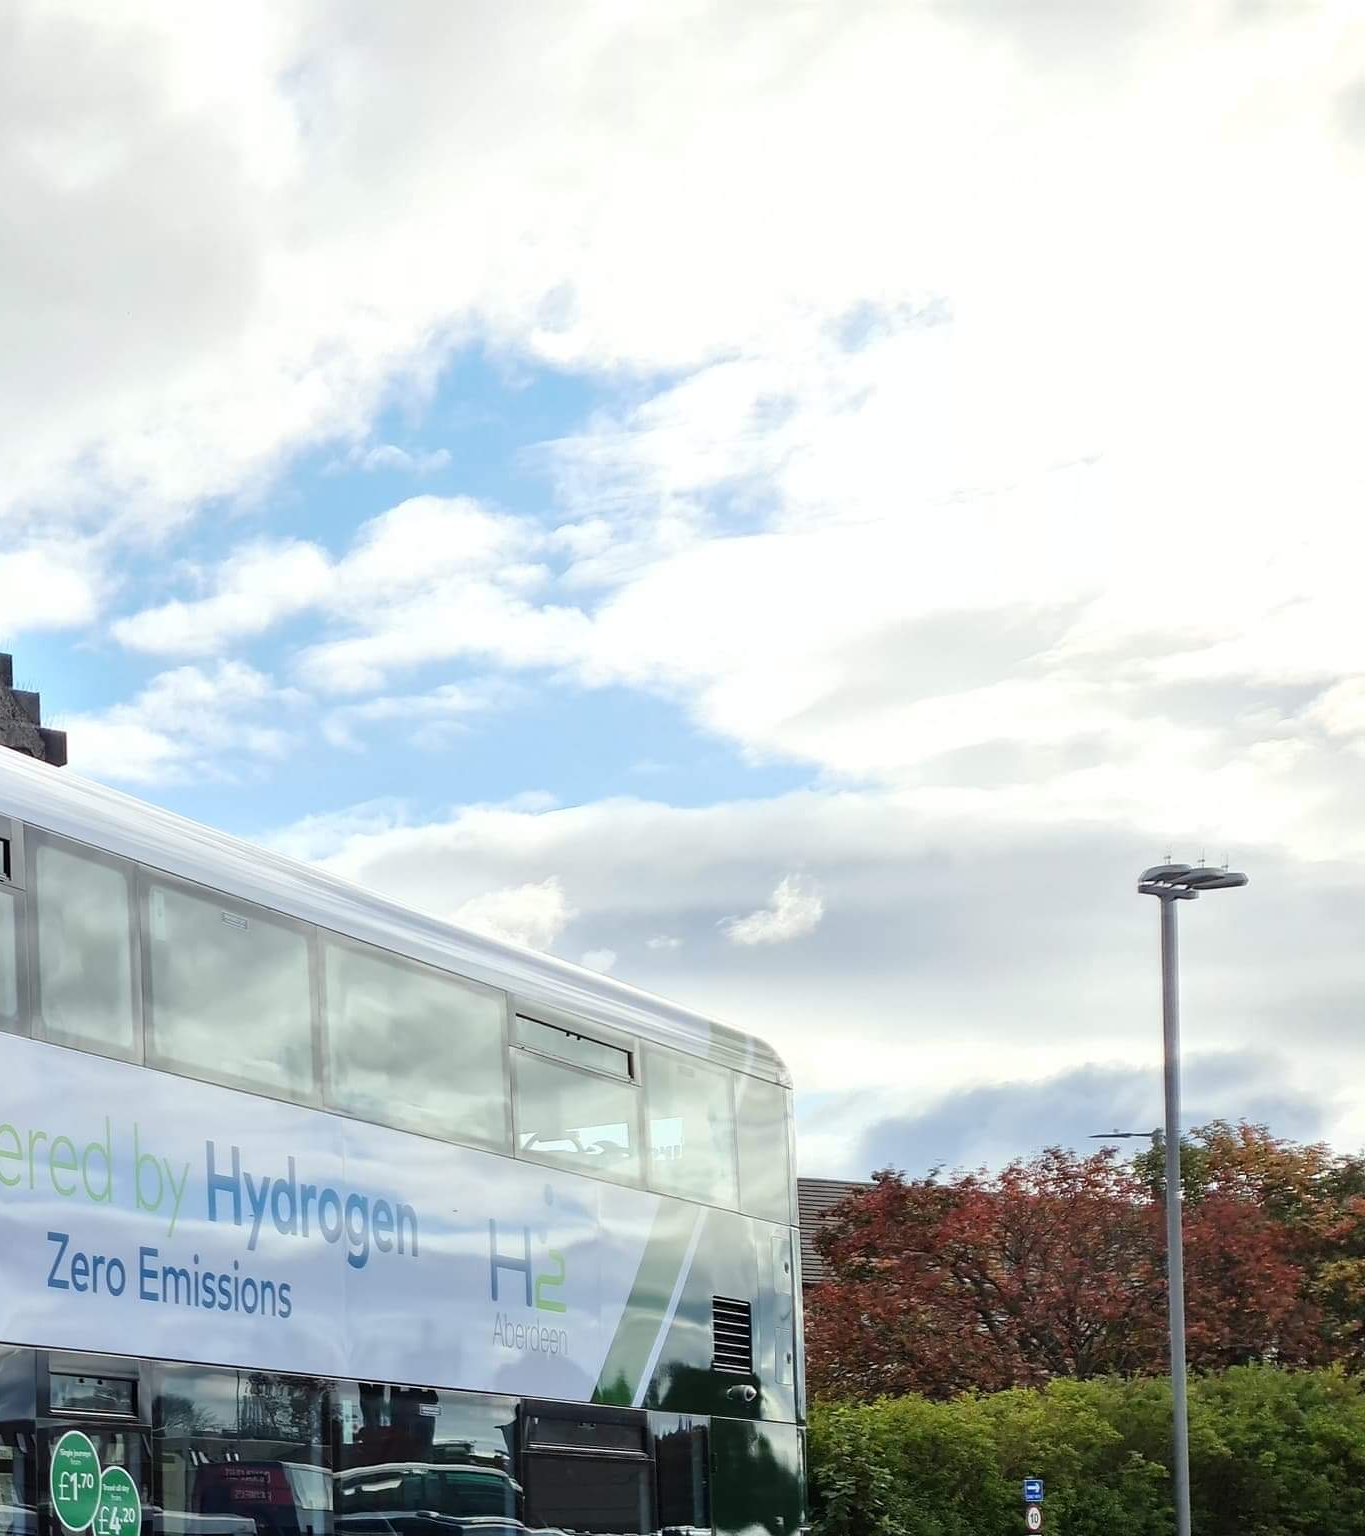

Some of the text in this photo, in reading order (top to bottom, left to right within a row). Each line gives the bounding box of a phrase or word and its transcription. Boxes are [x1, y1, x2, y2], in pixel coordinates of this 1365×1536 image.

[134, 1122, 190, 1237] by
[206, 1140, 419, 1269] Hydrogen
[47, 1231, 293, 1318] Zero Emissions
[489, 1218, 567, 1313] H2
[492, 1312, 568, 1356] Aberdeen
[58, 1471, 94, 1501] £1.70
[97, 1506, 136, 1535] £4.20
[1030, 1513, 1038, 1524] 10
